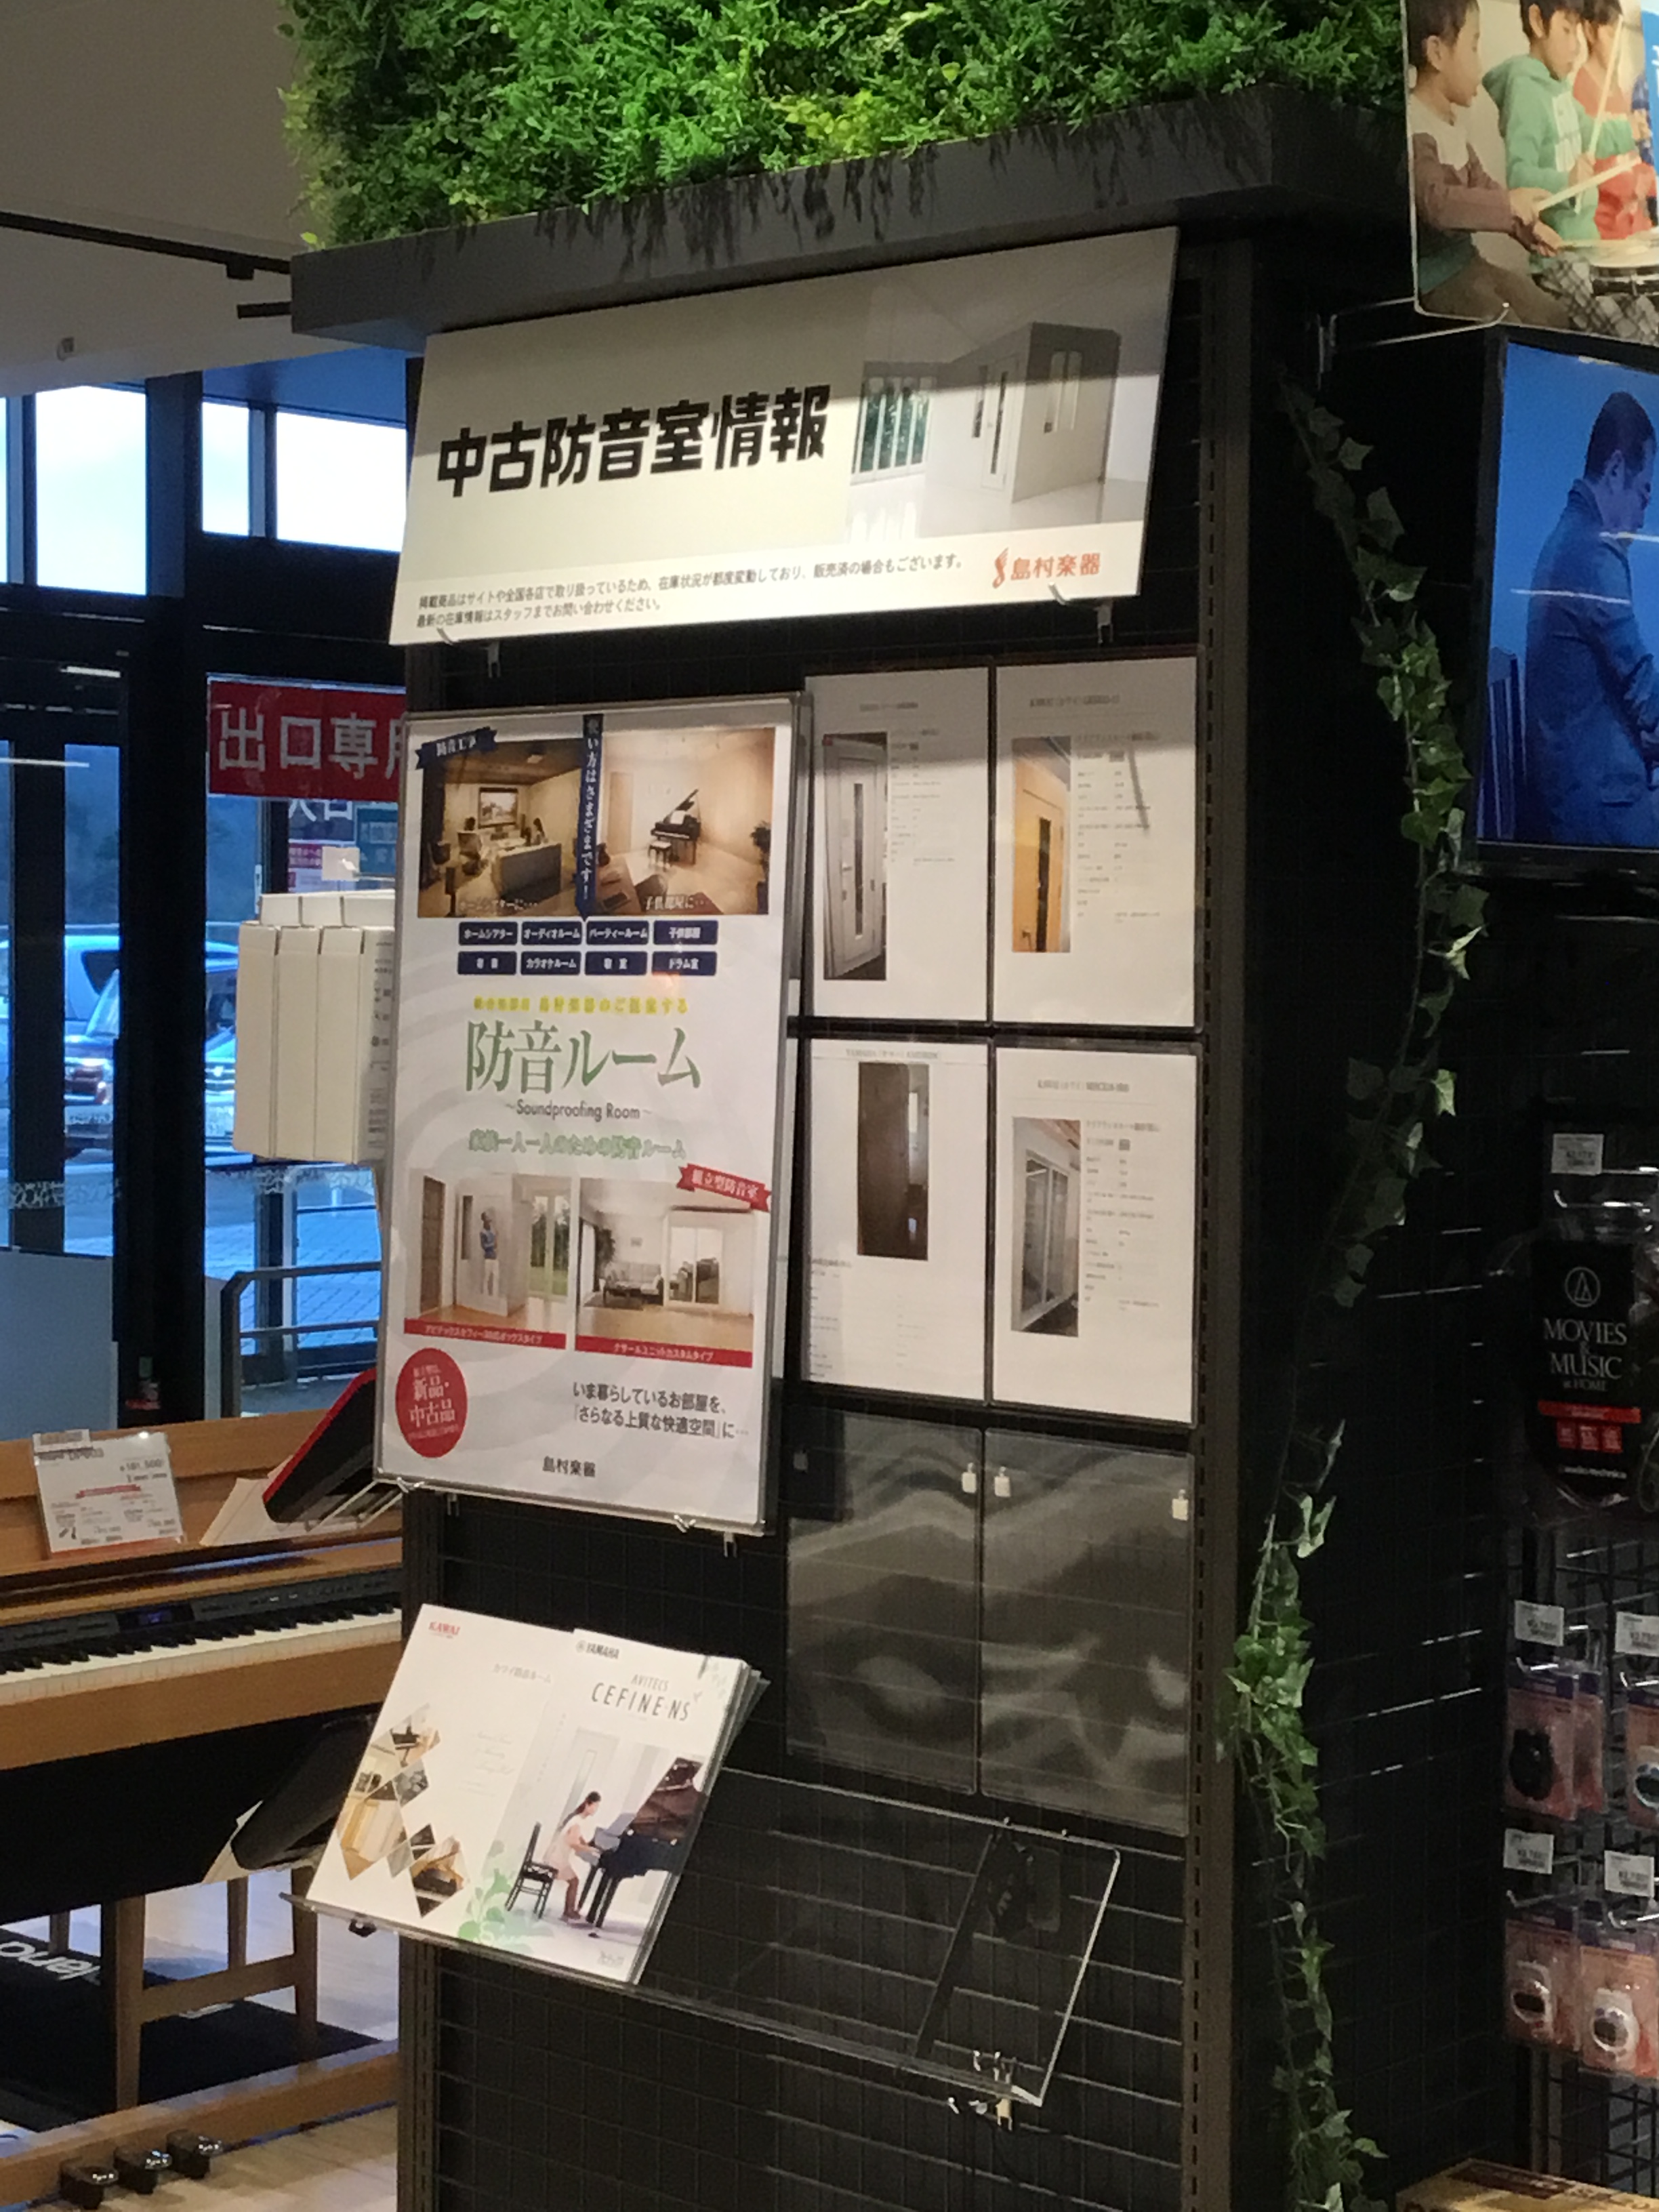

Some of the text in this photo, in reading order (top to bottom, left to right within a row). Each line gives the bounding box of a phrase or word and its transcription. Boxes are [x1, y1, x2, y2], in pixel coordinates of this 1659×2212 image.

[436, 384, 831, 497] 中古防音室情報
[1010, 552, 1100, 580] 島村楽器
[523, 928, 581, 939] オーディオルーム
[466, 1019, 701, 1094] 防音ルーム
[1543, 1317, 1628, 1346] MOVIES
[1550, 1352, 1622, 1380] MUSIC
[573, 1381, 726, 1414] いま暮らしているお部屋を、
[409, 1398, 455, 1428] 中古品
[542, 1456, 596, 1478] 島村楽器
[428, 1622, 461, 1636] KAWAI
[586, 1642, 620, 1660] YAMAHA
[631, 1673, 670, 1692] AVITECS
